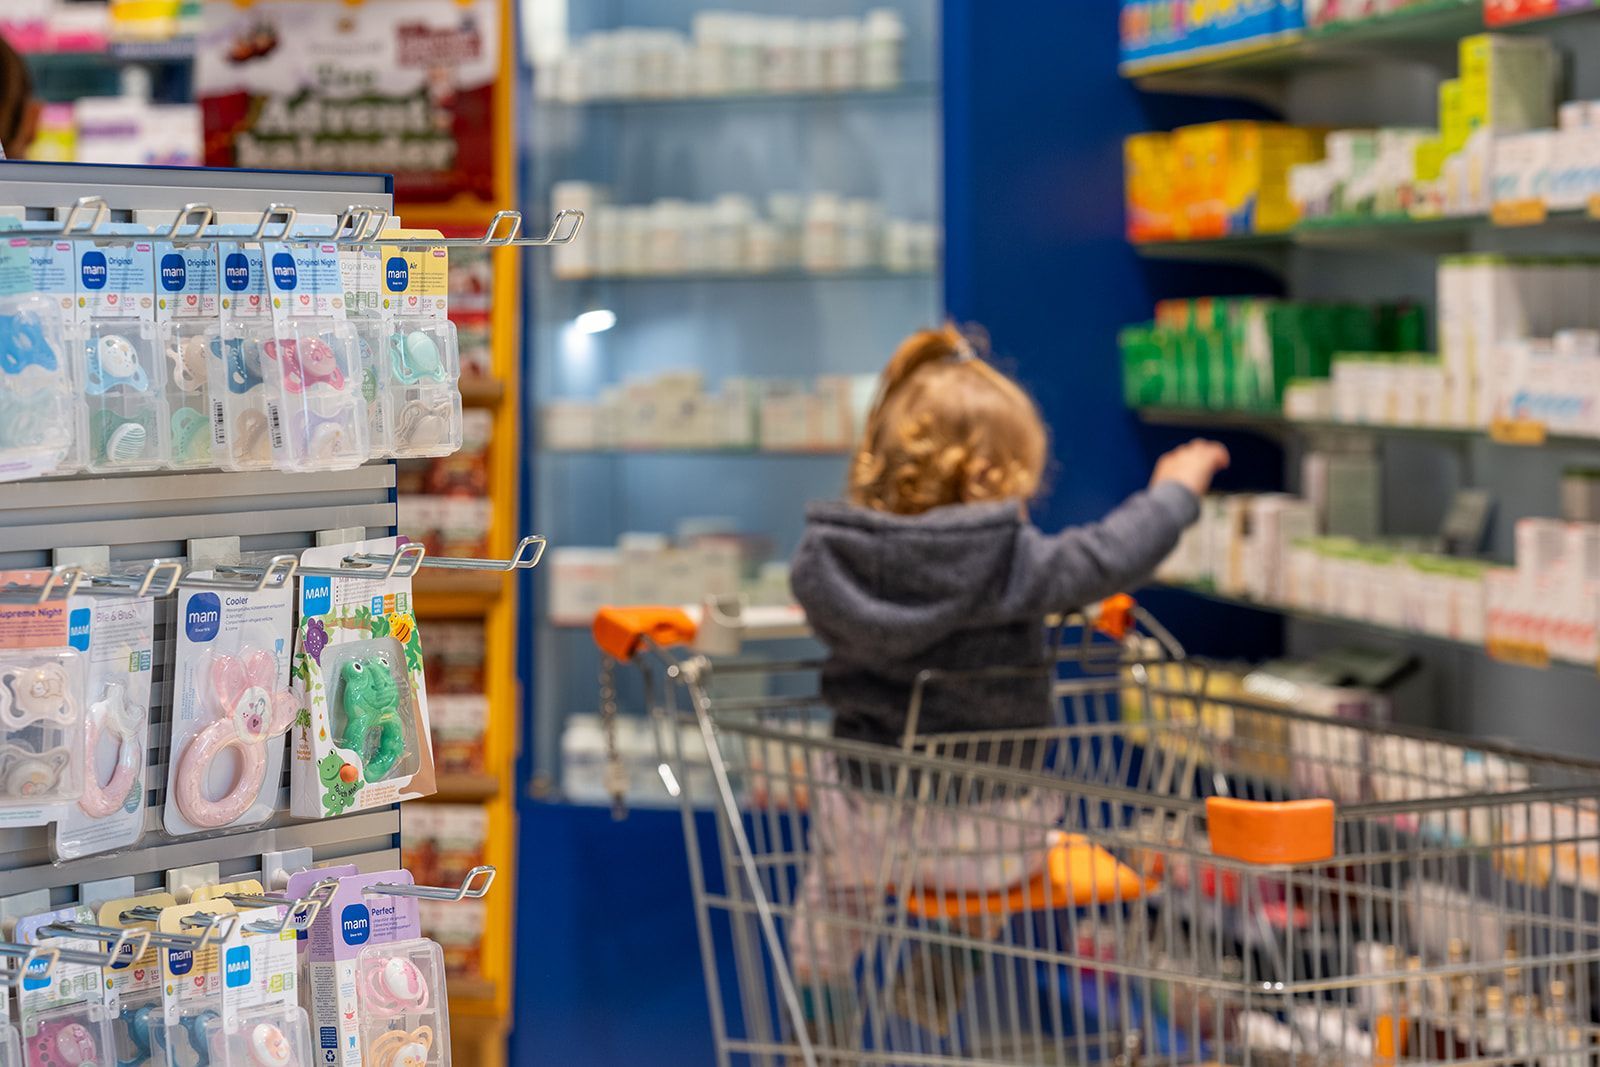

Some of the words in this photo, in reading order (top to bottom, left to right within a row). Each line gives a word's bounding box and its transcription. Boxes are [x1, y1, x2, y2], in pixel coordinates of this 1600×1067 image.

[108, 257, 133, 266] Original
[187, 258, 210, 268] Original
[297, 258, 320, 268] Original
[321, 259, 337, 268] Night
[83, 265, 105, 275] mam
[163, 268, 184, 277] mam
[227, 267, 248, 277] mam
[274, 266, 296, 275] mam
[387, 270, 407, 279] mam
[305, 587, 329, 599] MAM
[225, 596, 248, 606] Cooler
[0, 610, 36, 619] upreme
[38, 608, 62, 618] Night
[189, 611, 218, 623] mam
[70, 625, 89, 636] MAM
[371, 906, 395, 916] Perfect
[344, 918, 367, 930] mam
[170, 950, 192, 962] mam
[227, 960, 249, 973] MAM
